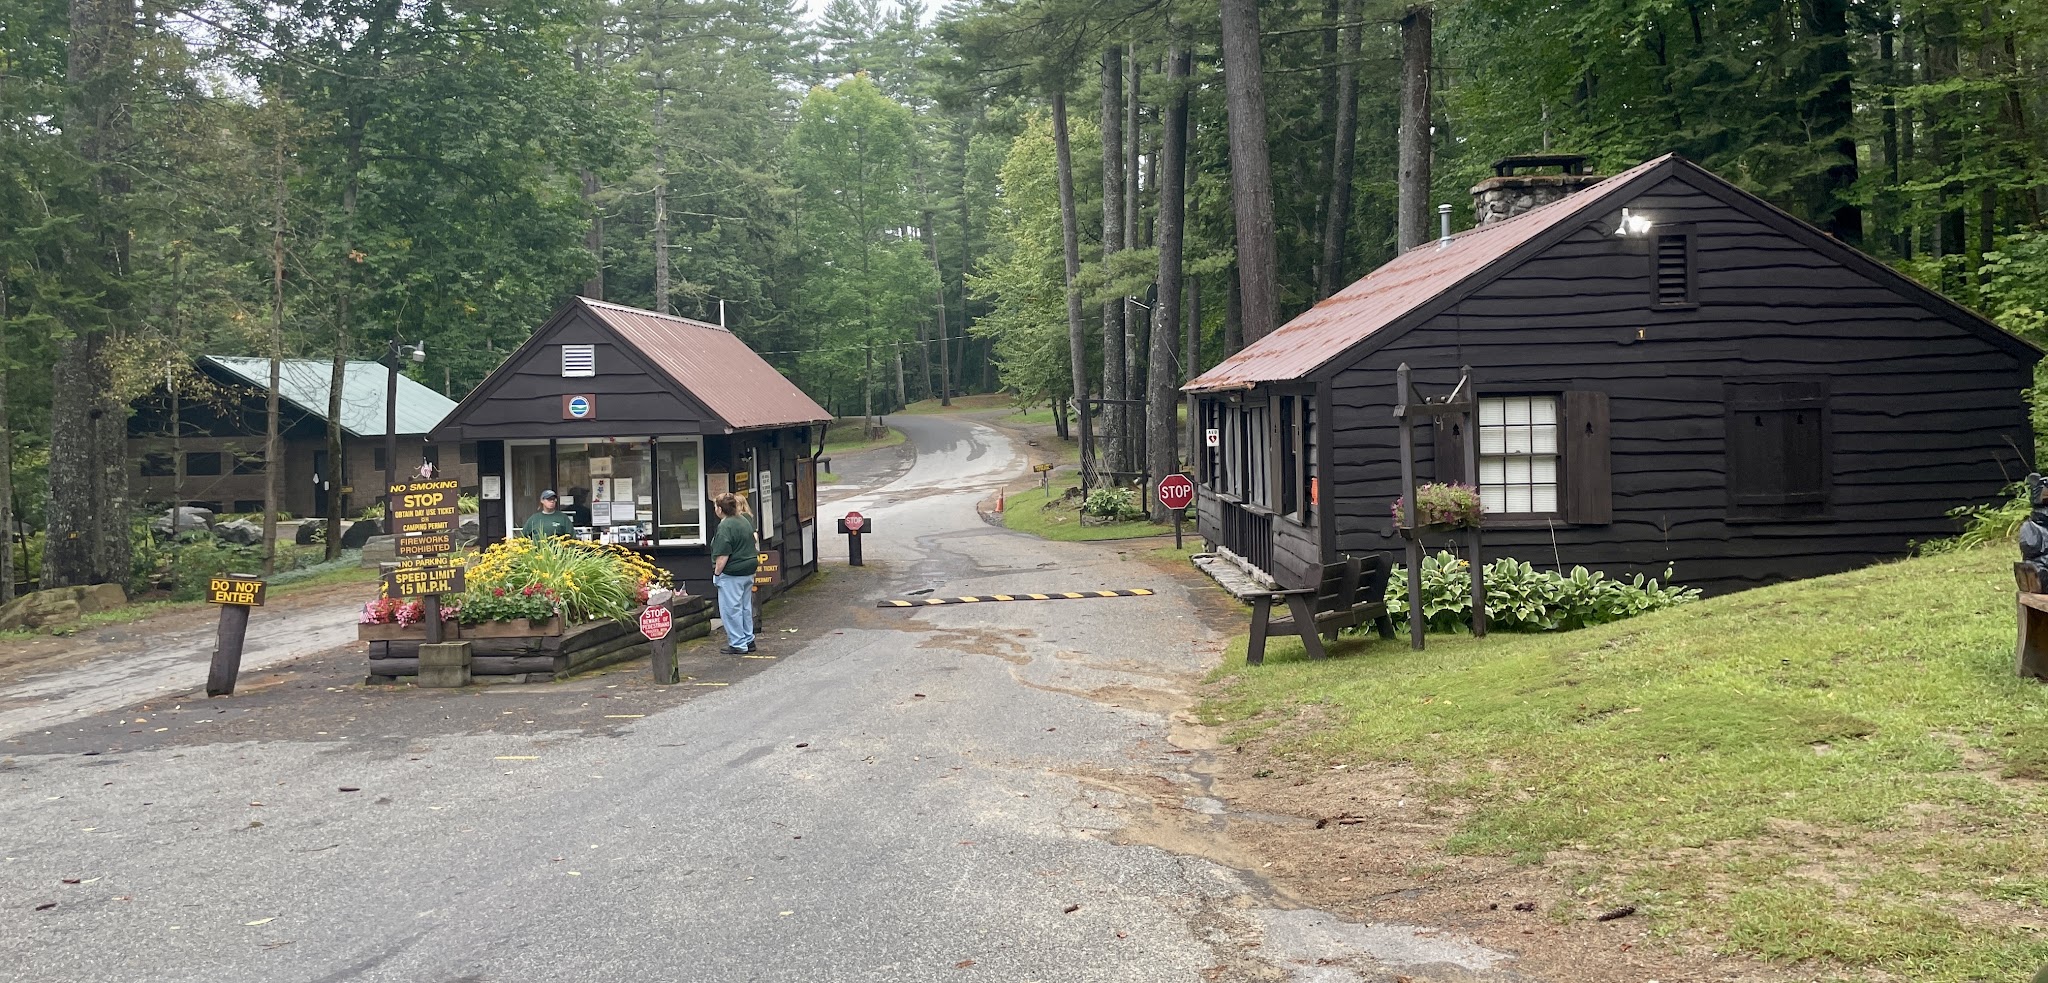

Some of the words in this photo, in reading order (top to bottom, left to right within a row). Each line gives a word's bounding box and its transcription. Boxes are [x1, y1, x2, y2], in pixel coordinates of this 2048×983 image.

[1638, 329, 1644, 339] 1
[390, 484, 406, 493] NO
[410, 480, 458, 491] SMOKING
[1162, 484, 1190, 498] STOP
[404, 492, 444, 508] STOP
[394, 510, 414, 518] OBTAIN
[426, 508, 436, 516] USE
[437, 506, 455, 514] TICKET
[846, 516, 862, 524] STOP
[402, 523, 428, 532] CAMPING
[428, 522, 448, 530] PERMIT
[400, 535, 449, 546] FIREWORKS
[400, 544, 450, 554] PROHIBITED
[416, 558, 448, 566] PARKING
[396, 572, 427, 584] SPEED
[430, 569, 456, 580] LIMIT
[212, 580, 230, 591] DO
[236, 582, 262, 593] NOT
[400, 584, 414, 594] 15
[416, 580, 452, 594] M.P.H.
[216, 591, 254, 602] ENTER
[646, 609, 666, 618] STOP
[642, 622, 670, 630] PEDESTRIANS
